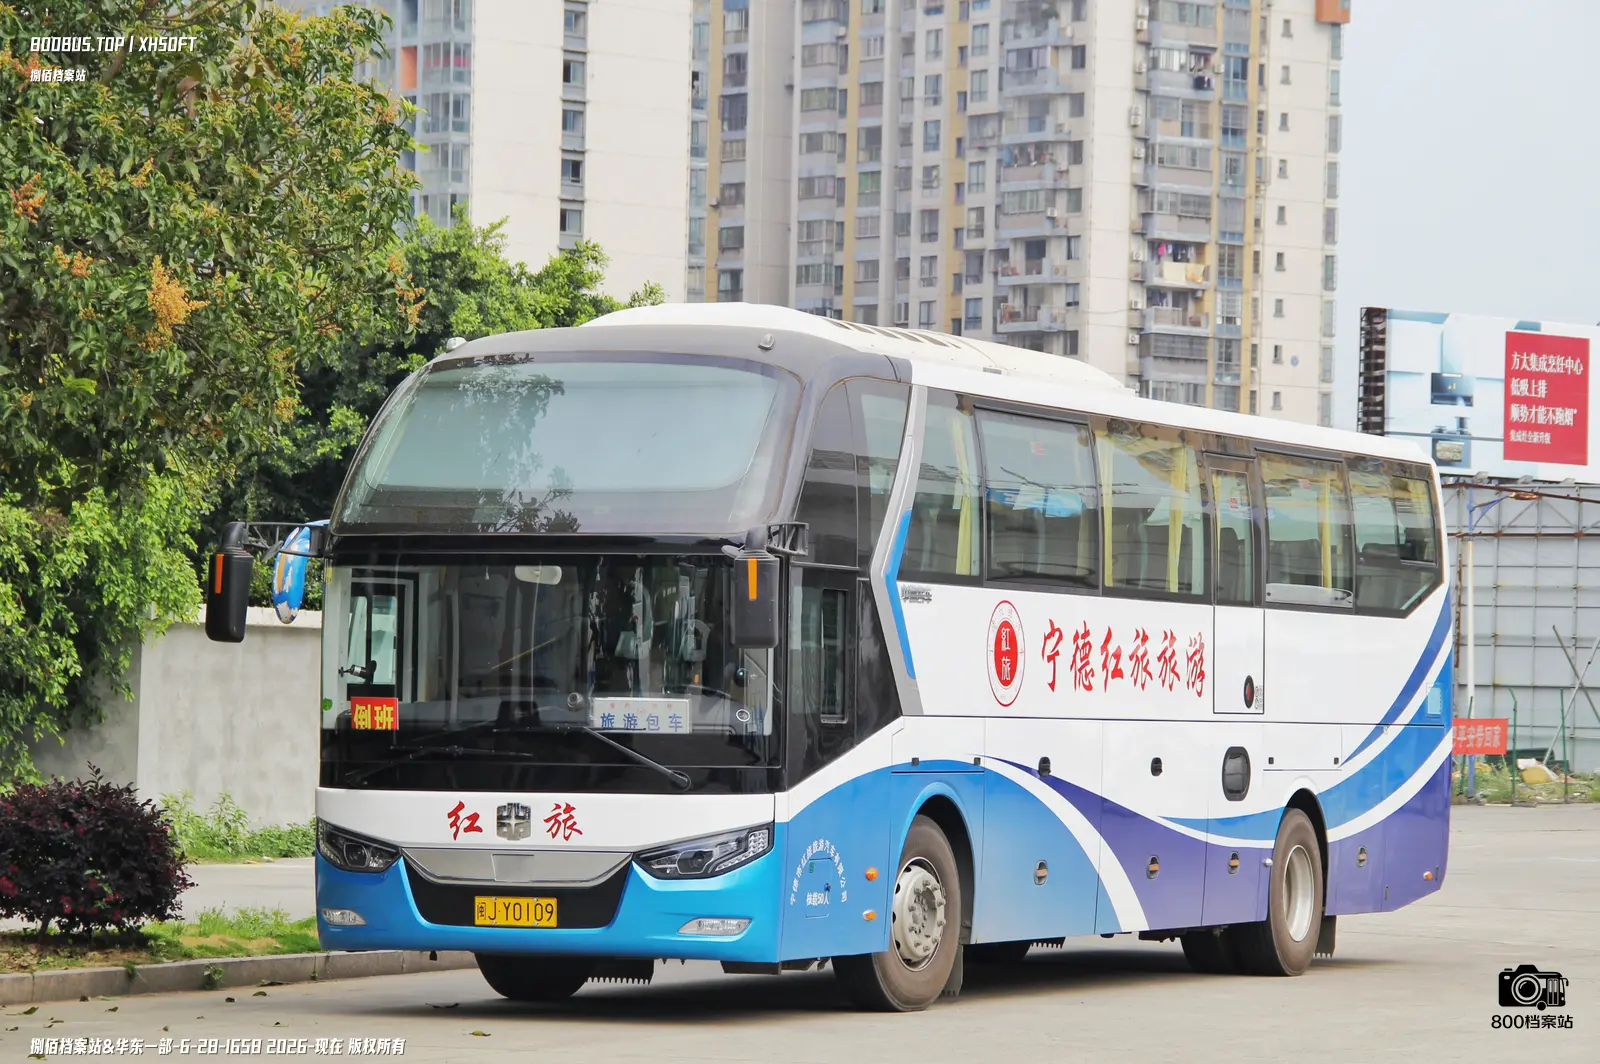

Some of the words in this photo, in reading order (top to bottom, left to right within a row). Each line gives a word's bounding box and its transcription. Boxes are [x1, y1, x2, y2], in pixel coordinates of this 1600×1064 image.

[1511, 351, 1584, 375] 方太集成烹饪中心
[1510, 377, 1548, 398] 低吸上排
[1041, 617, 1206, 698] 宁德红旅旅游
[353, 703, 394, 730] 倒班
[600, 712, 684, 732] 旅游包车
[447, 800, 483, 841] 红
[543, 802, 583, 842] 旅
